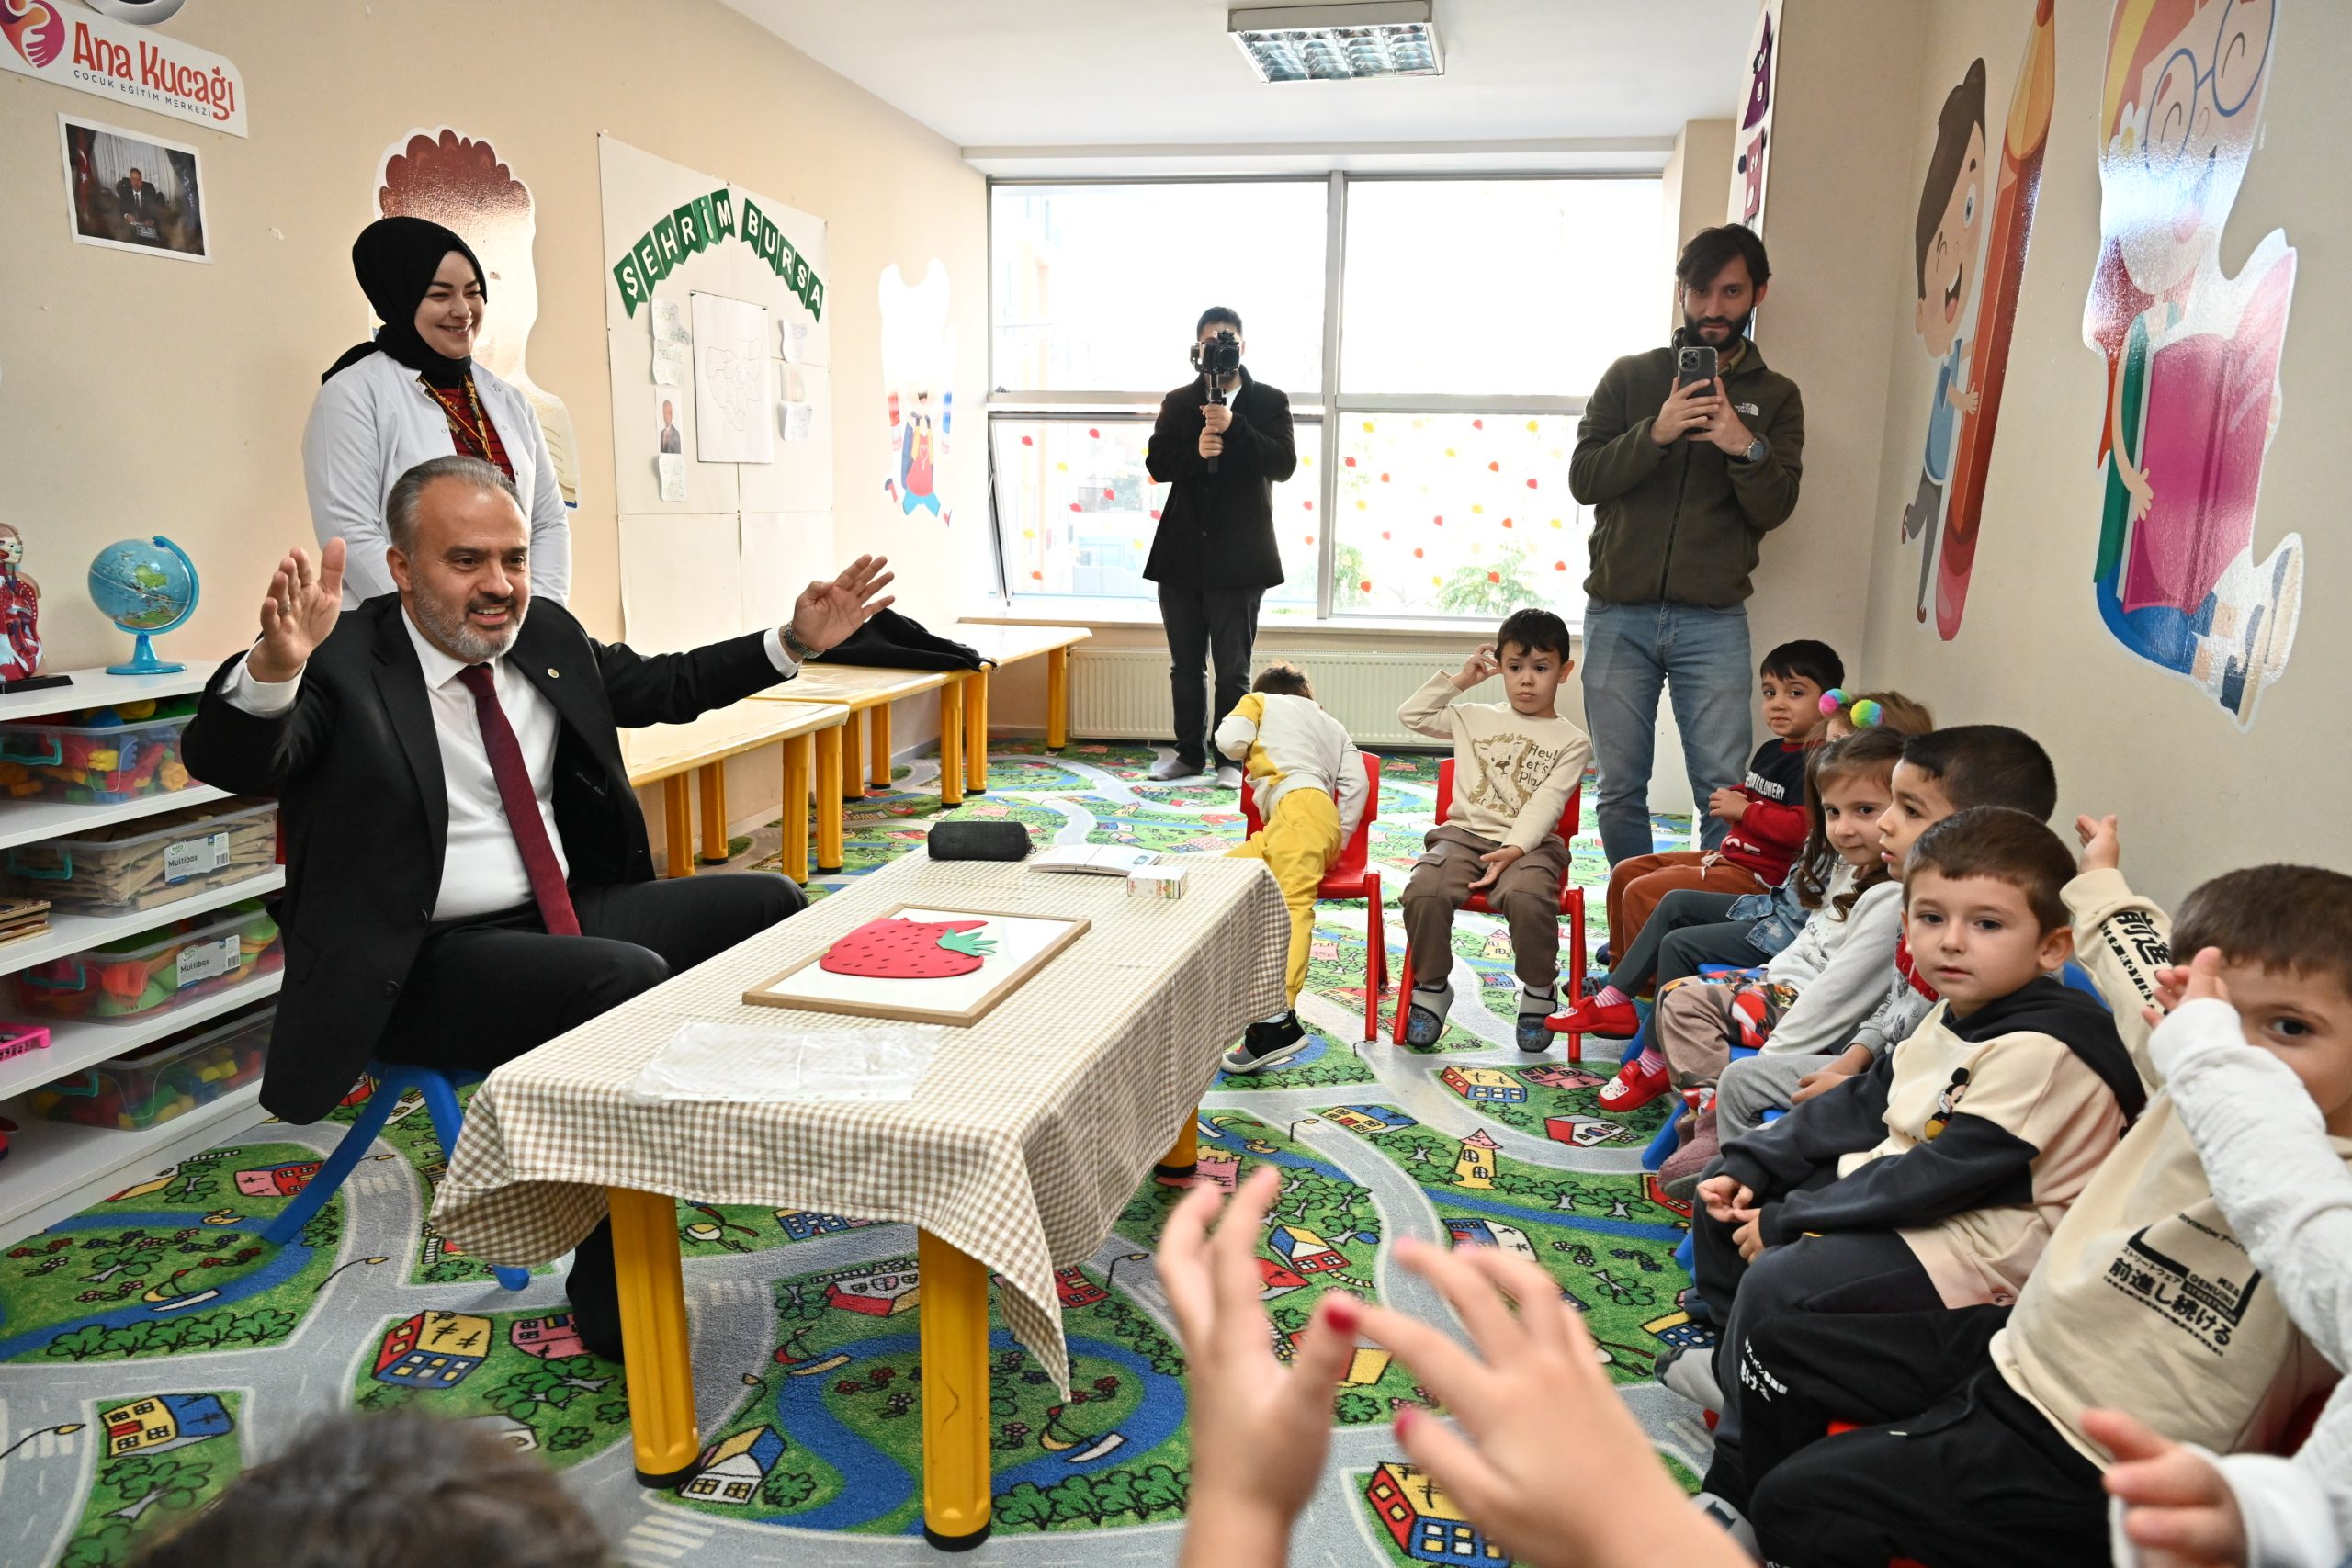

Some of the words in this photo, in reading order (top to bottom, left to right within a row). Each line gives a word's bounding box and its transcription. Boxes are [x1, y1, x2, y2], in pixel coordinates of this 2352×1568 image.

[74, 21, 134, 81] Ana
[139, 40, 235, 121] Kucağı
[74, 70, 115, 88] ÇOCUK
[120, 84, 160, 101] EĞİTİM
[165, 96, 211, 117] MERKEZİ
[622, 199, 732, 299] ŞEHRİM
[748, 209, 820, 309] BURSA
[1518, 756, 1549, 774] Let's
[1528, 742, 1559, 762] Hey!
[168, 854, 198, 868] Multibox
[180, 959, 209, 974] Multibox
[2188, 1273, 2235, 1306] GENUINE
